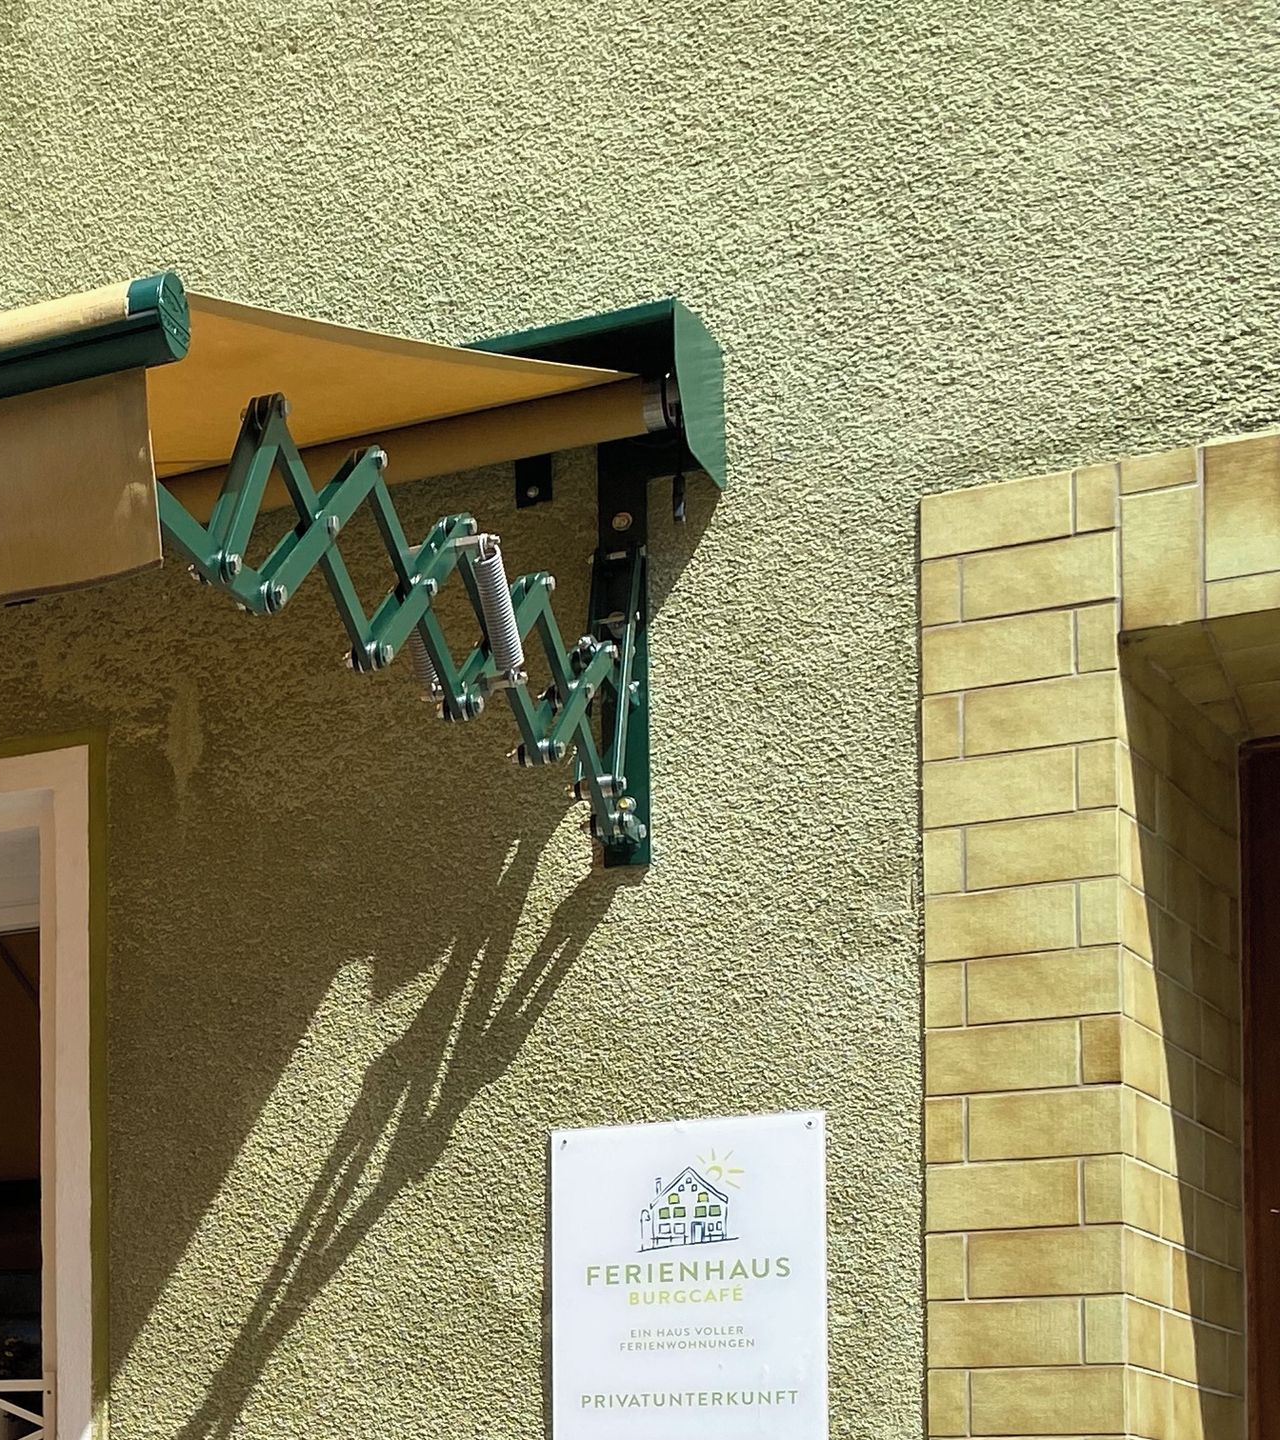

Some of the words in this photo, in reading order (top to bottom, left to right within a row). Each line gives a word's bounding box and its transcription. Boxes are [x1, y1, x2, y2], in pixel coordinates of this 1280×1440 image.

[586, 1257, 791, 1286] FERIENHAUS
[629, 1284, 744, 1306] BURGCAFÉ
[630, 1328, 652, 1339] EIN
[656, 1327, 691, 1338] HAUS
[695, 1326, 744, 1337] VOLLER
[619, 1338, 756, 1352] FERIENWOHNUNGEN
[580, 1390, 799, 1409] PRIVATUNTERKUNFT
